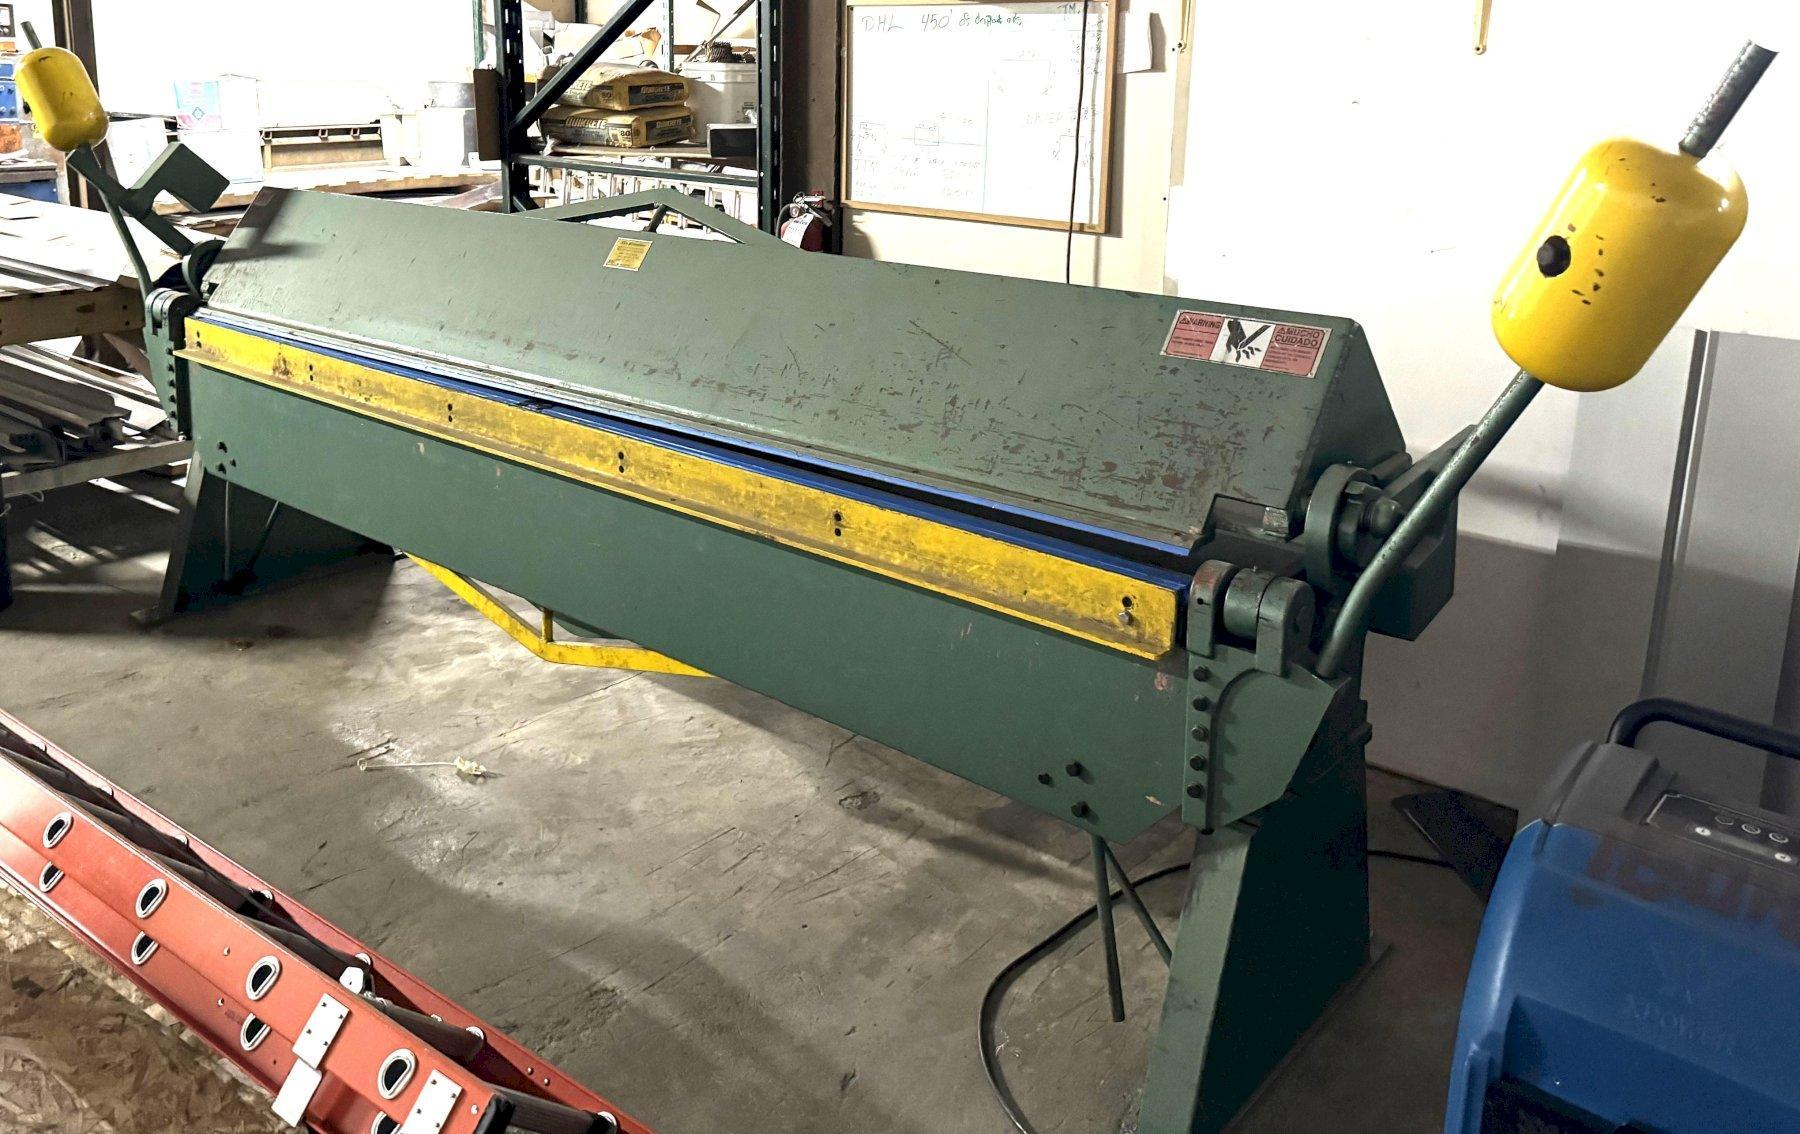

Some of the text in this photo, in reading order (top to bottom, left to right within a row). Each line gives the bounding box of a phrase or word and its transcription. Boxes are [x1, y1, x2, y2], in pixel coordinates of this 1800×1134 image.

[862, 14, 903, 32] DHL
[566, 116, 607, 129] QUIKRETE
[1188, 317, 1222, 330] WARNING
[1286, 328, 1320, 339] MUCHO
[1274, 334, 1318, 347] CUIDADO
